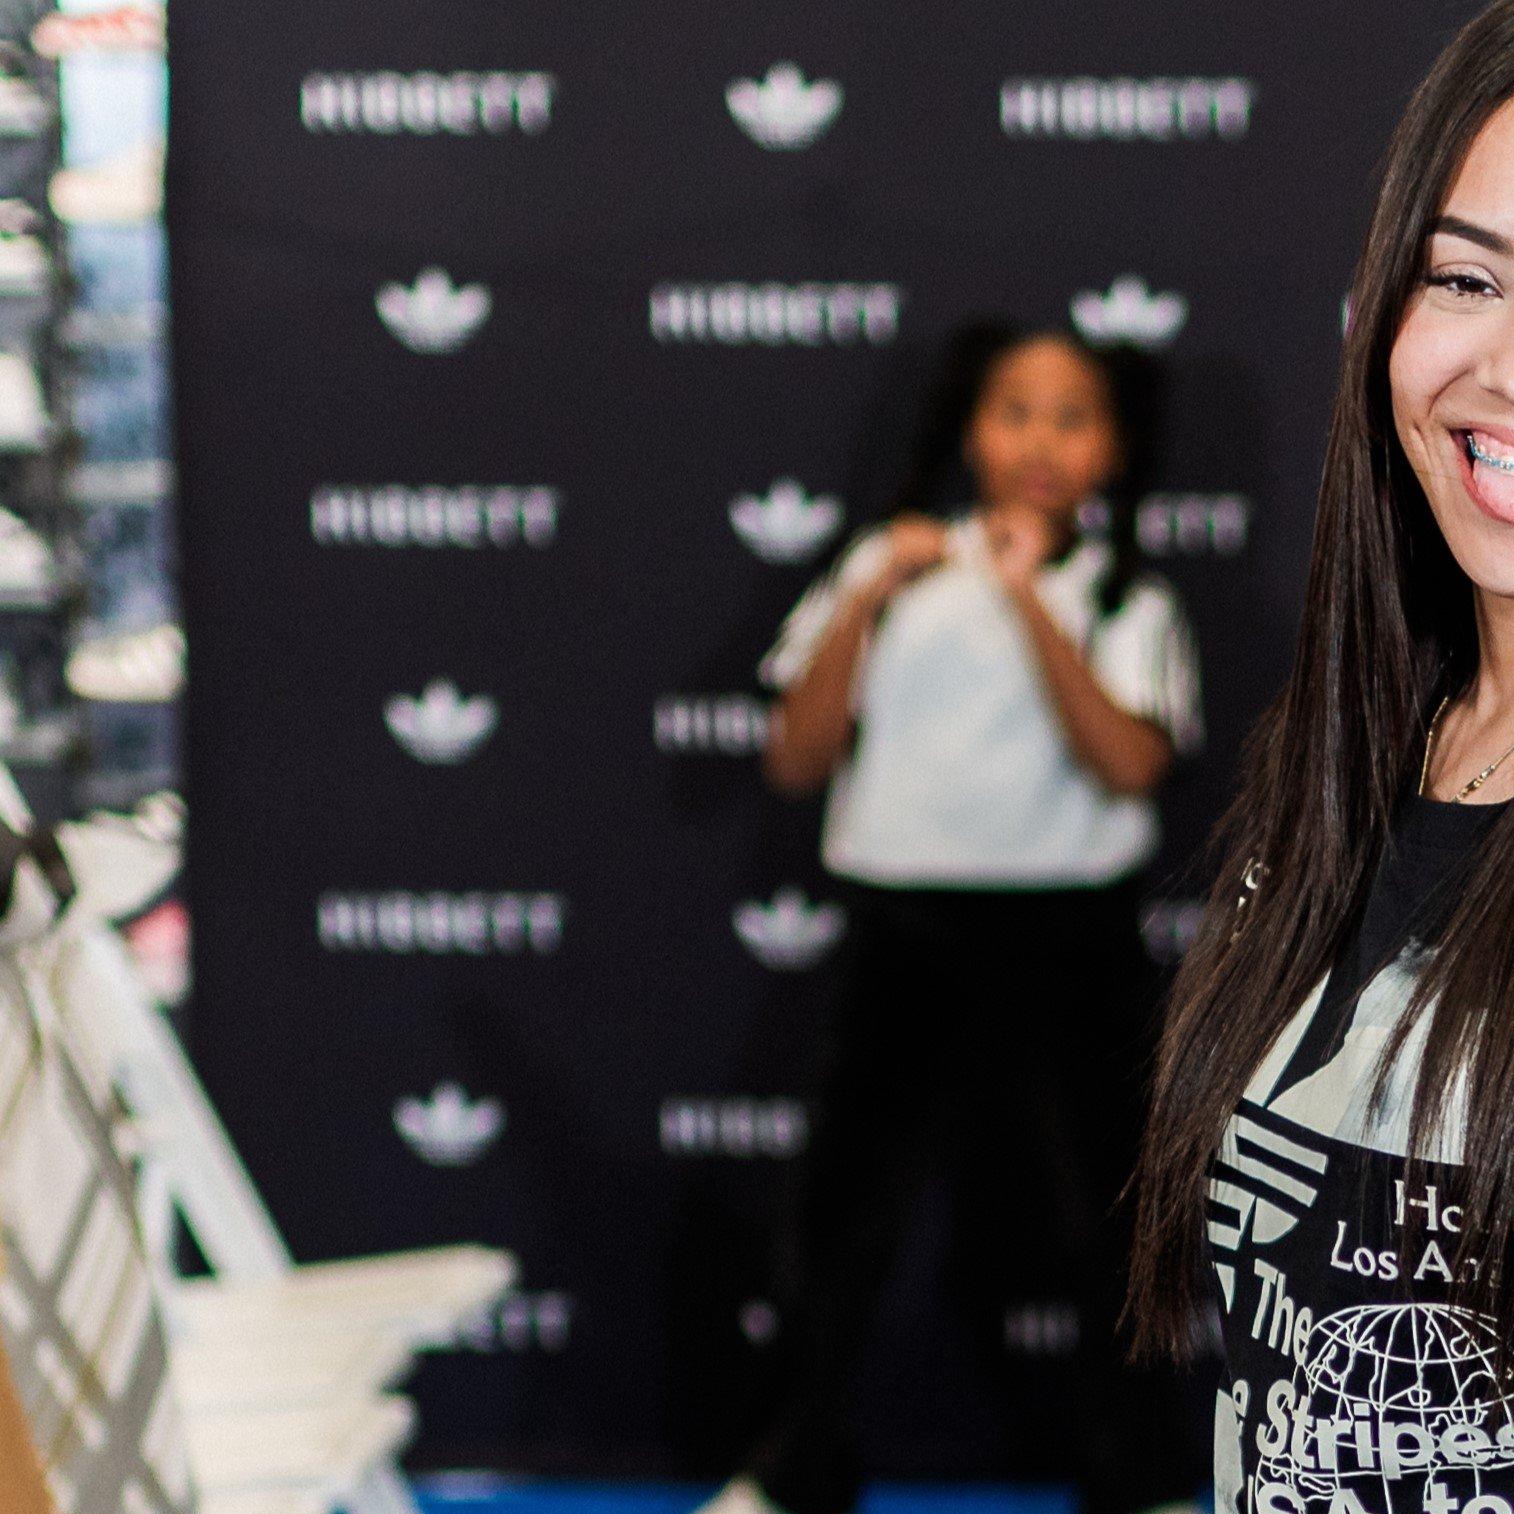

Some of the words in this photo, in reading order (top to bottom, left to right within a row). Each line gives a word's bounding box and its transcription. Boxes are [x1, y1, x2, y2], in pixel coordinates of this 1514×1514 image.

[302, 72, 553, 134] HIBBETT
[1001, 78, 1253, 138] HIBBETT
[650, 282, 900, 345] HIBBETT
[311, 485, 558, 547] HIBBETT
[1330, 1221, 1399, 1281] Los
[1252, 1258, 1313, 1366] The
